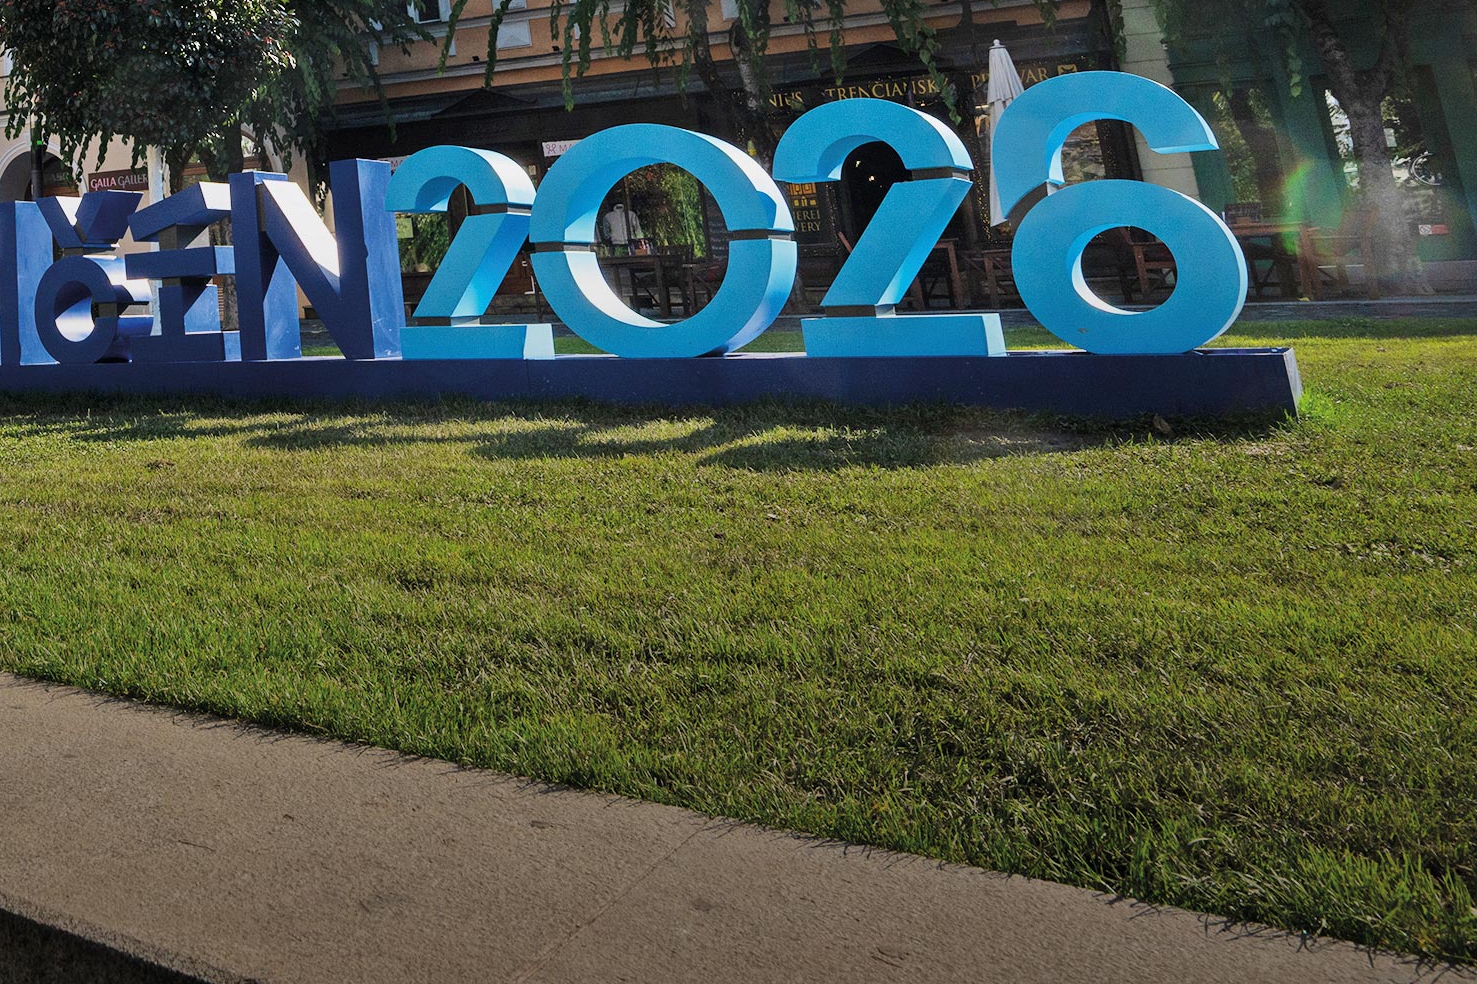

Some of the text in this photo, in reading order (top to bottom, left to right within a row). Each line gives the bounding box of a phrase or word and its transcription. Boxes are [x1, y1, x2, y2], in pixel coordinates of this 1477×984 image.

[826, 79, 948, 100] TRENČIANSK
[117, 173, 149, 189] GALLER
[384, 71, 1248, 357] 2026
